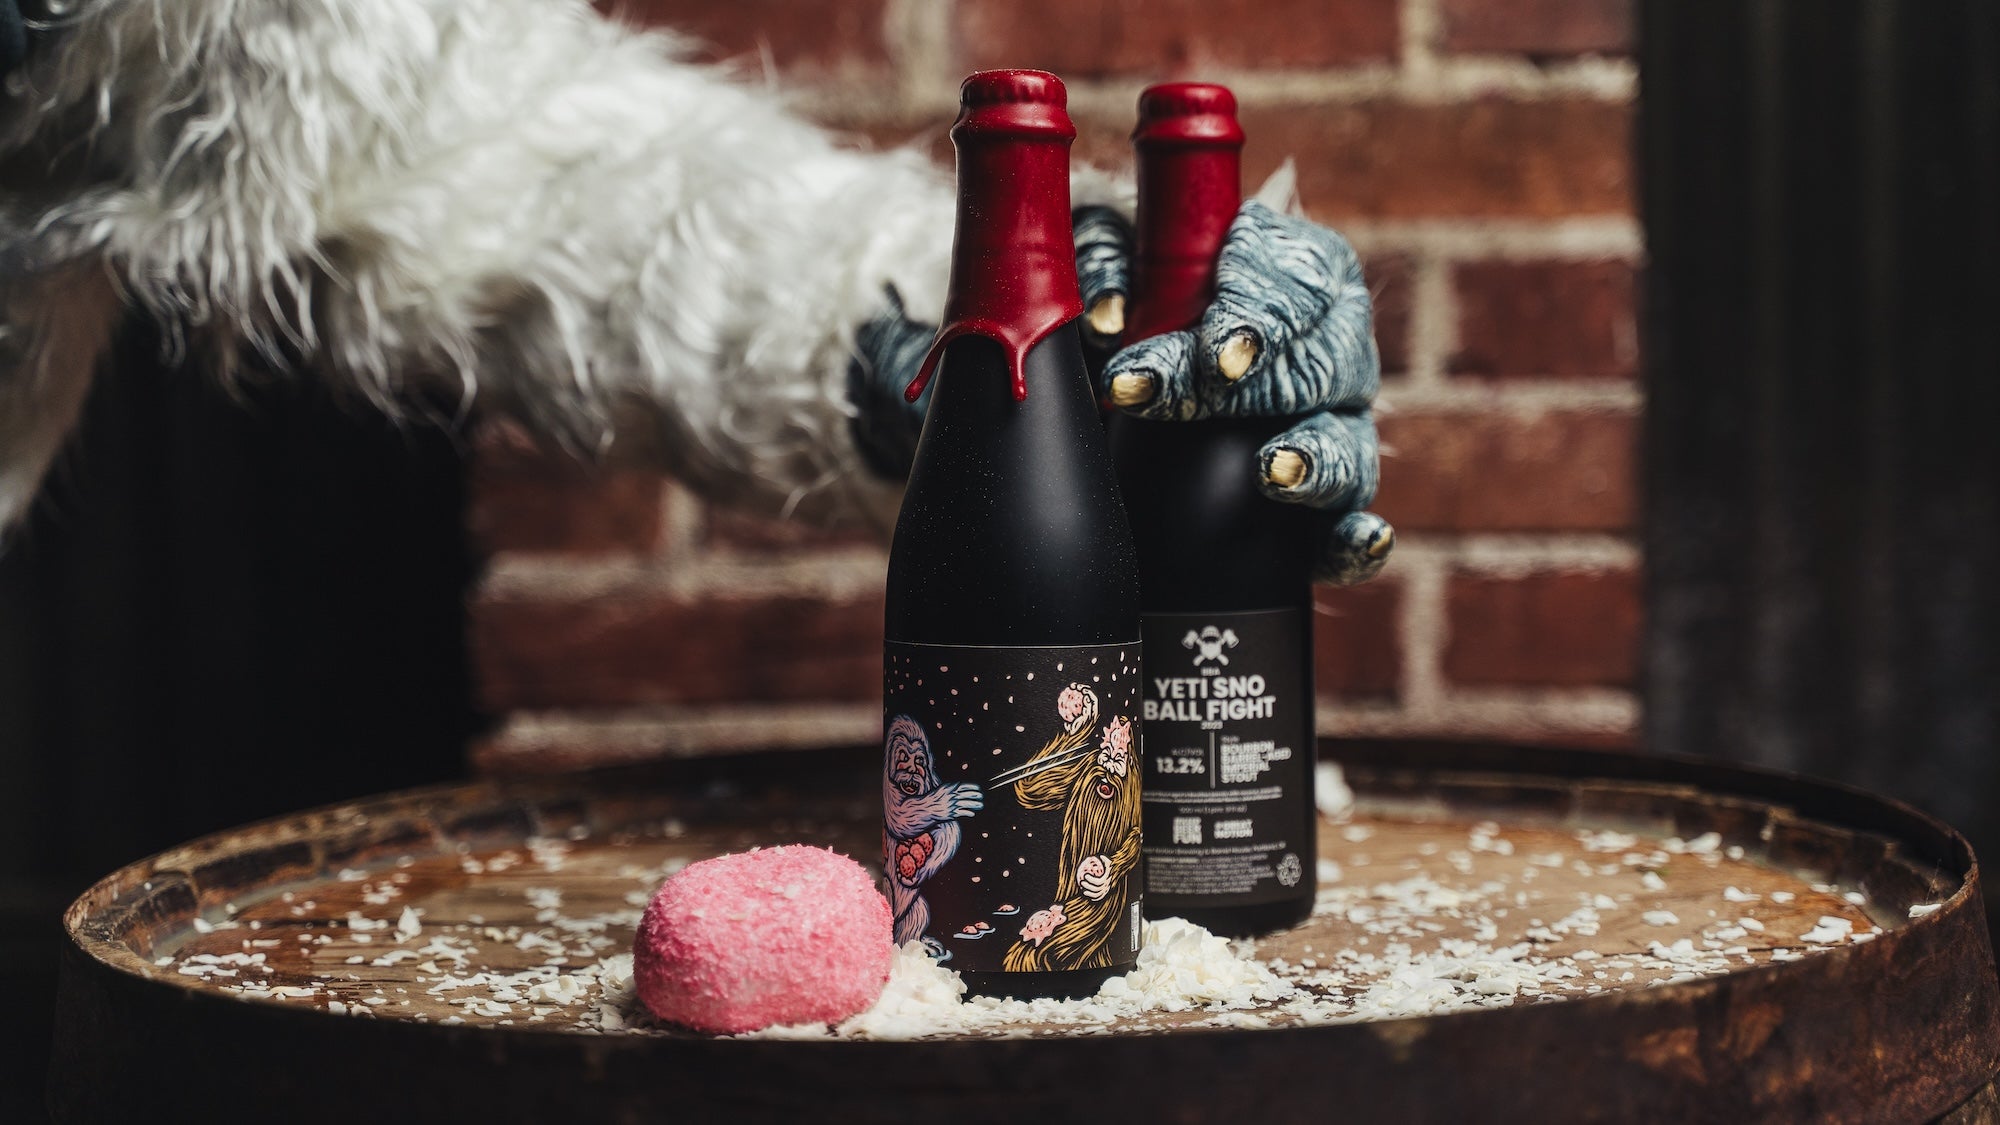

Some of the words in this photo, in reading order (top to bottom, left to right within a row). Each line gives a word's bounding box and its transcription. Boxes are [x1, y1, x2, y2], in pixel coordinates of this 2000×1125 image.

[1154, 677, 1208, 699] YETI
[1212, 674, 1266, 699] SNO
[1143, 699, 1203, 721] BALL
[1206, 695, 1277, 721] FIGHT
[1156, 757, 1206, 774] 13.2%
[1220, 772, 1258, 784] STOUT
